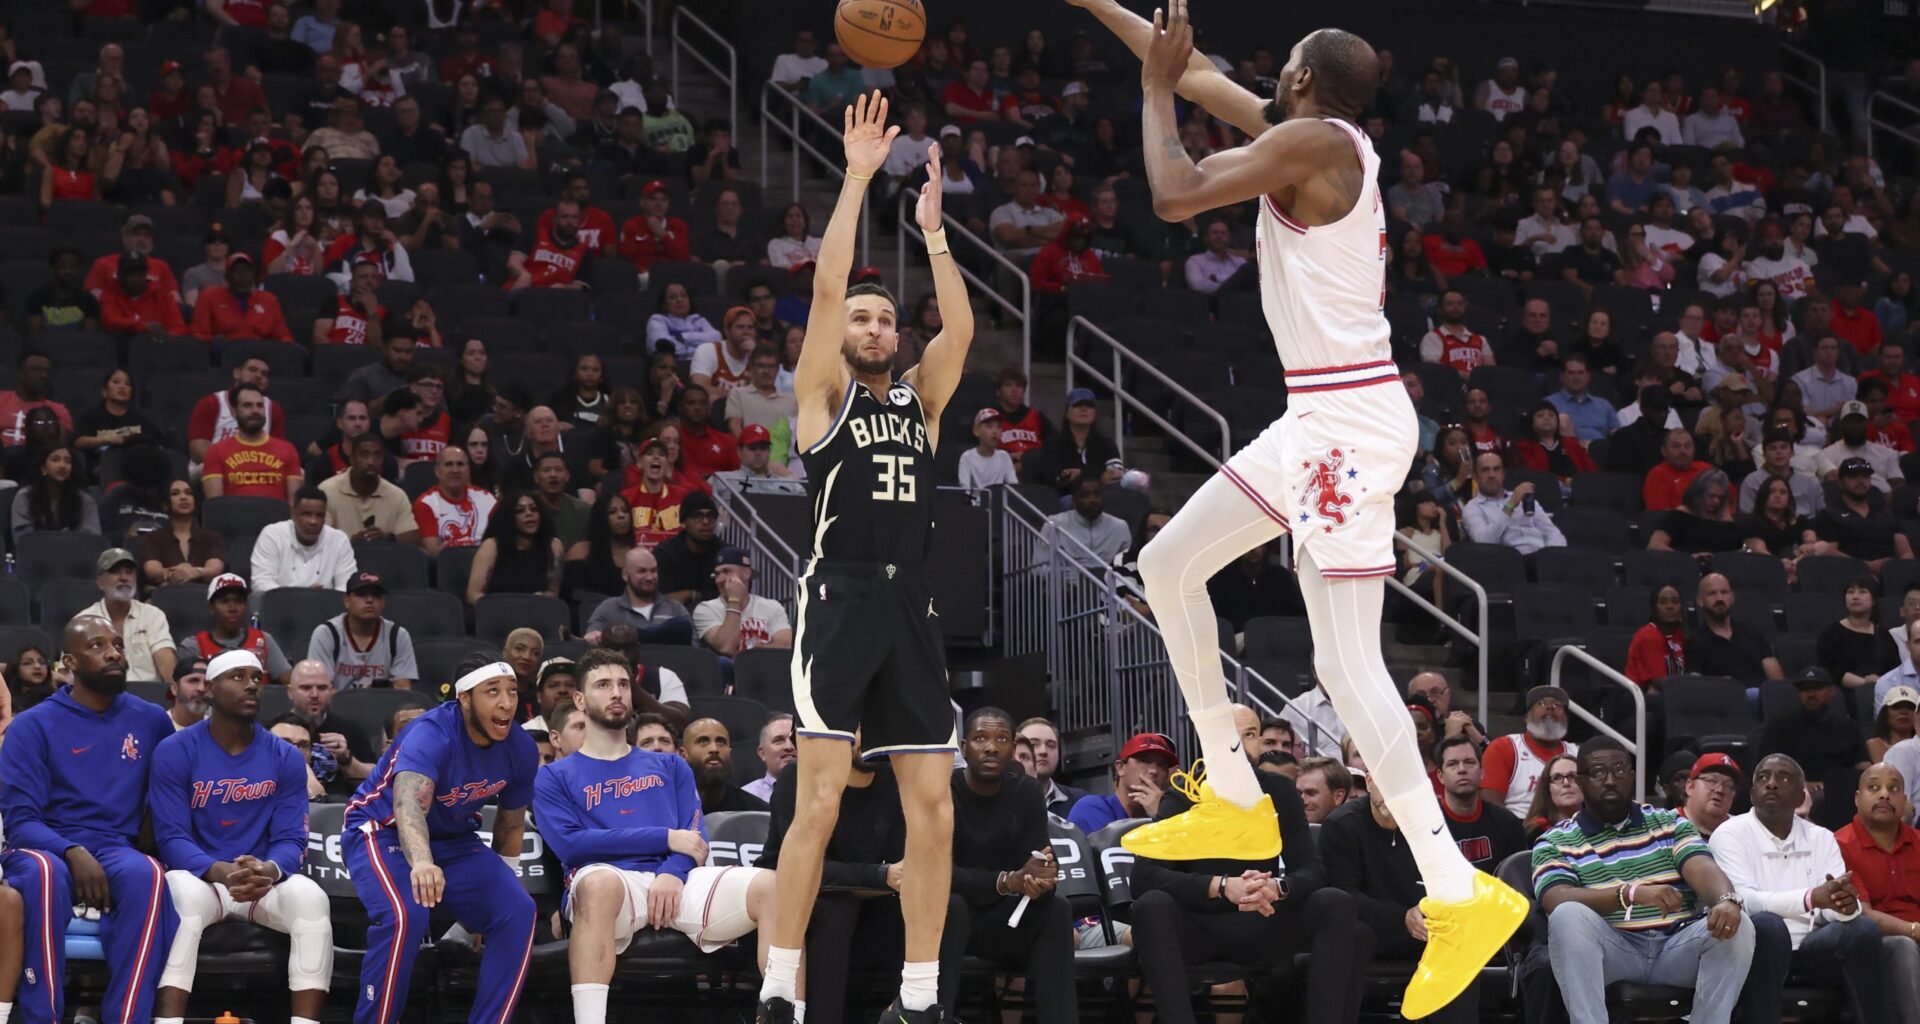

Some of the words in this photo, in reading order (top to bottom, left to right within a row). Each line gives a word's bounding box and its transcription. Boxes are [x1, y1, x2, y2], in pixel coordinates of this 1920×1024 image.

[848, 413, 925, 454] BUCKS
[225, 450, 284, 470] HOUSTON
[872, 454, 916, 502] 35
[337, 662, 385, 678] ROCKETS
[191, 778, 277, 809] H-Town
[583, 774, 665, 812] H-Town
